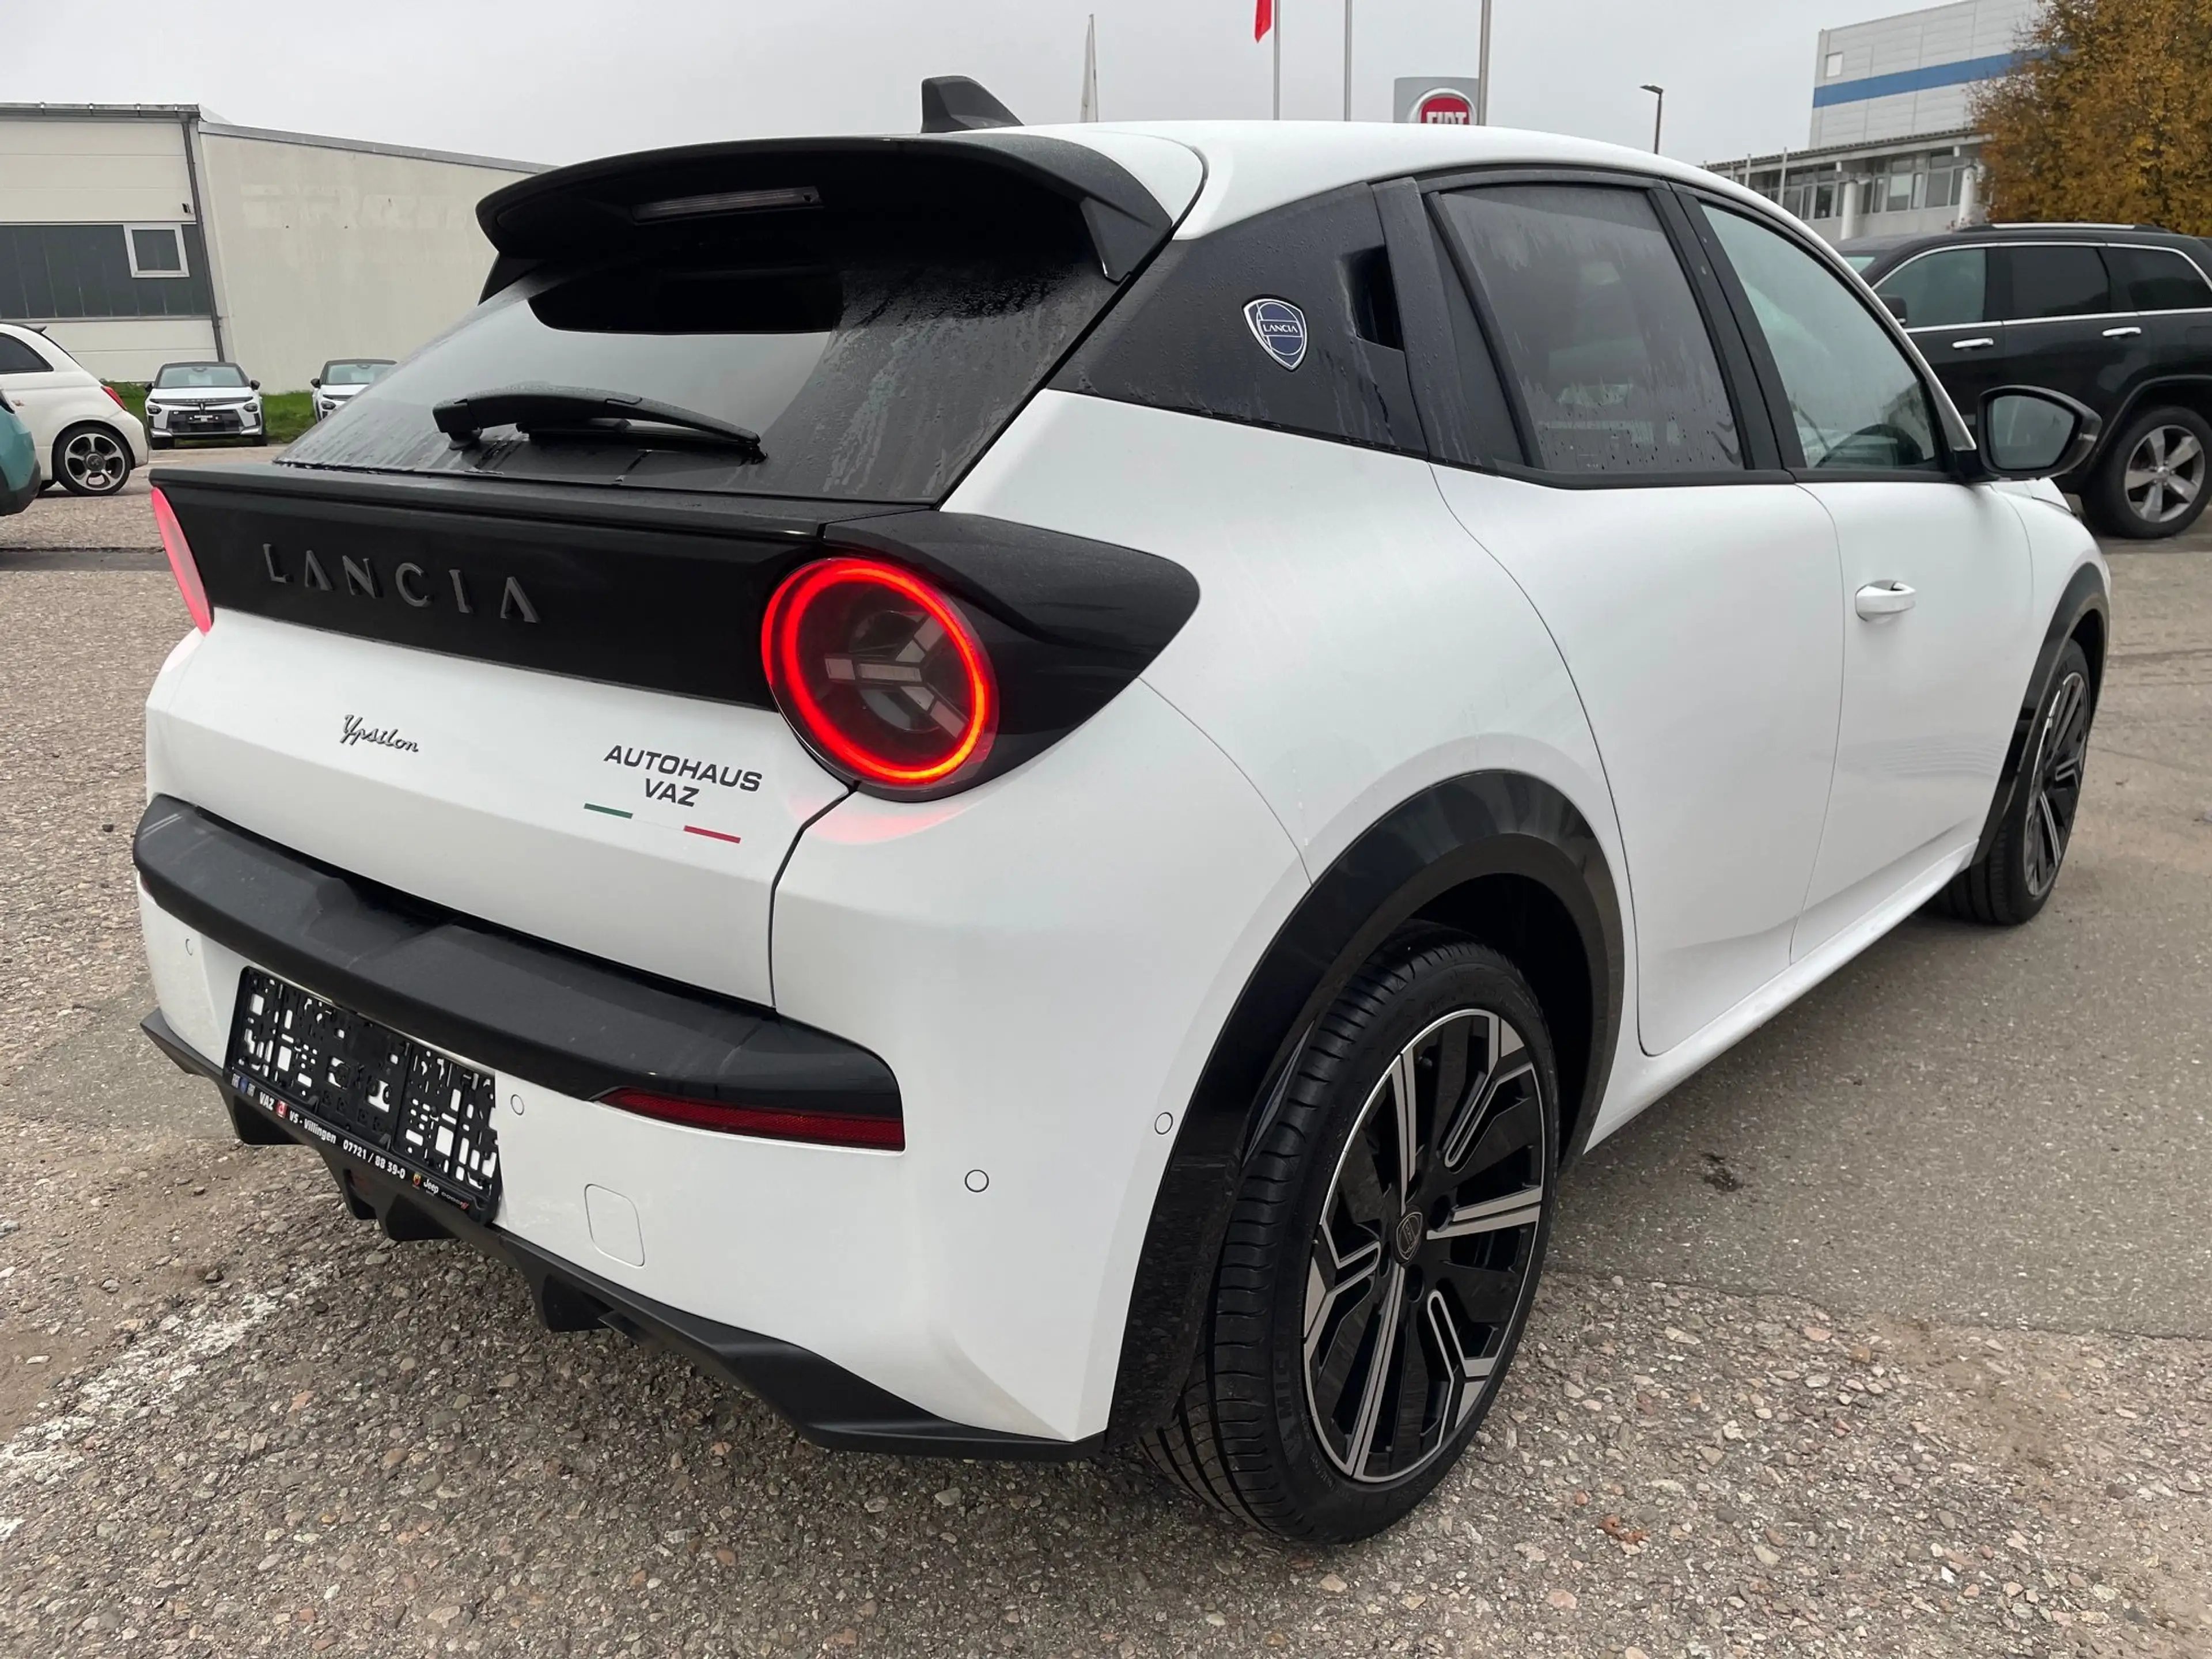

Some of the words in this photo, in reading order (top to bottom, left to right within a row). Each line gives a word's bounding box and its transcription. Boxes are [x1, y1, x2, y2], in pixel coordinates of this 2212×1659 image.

[1263, 324, 1298, 334] LANCIA
[263, 543, 541, 624] LANCIA
[339, 714, 419, 752] Ypsilon
[603, 744, 763, 792] AUTOHAUS
[645, 778, 700, 808] VAZ
[260, 1092, 275, 1111] VAZ
[304, 1119, 337, 1145] Villingen
[343, 1139, 367, 1160] 07721
[423, 1179, 438, 1195] Jeep
